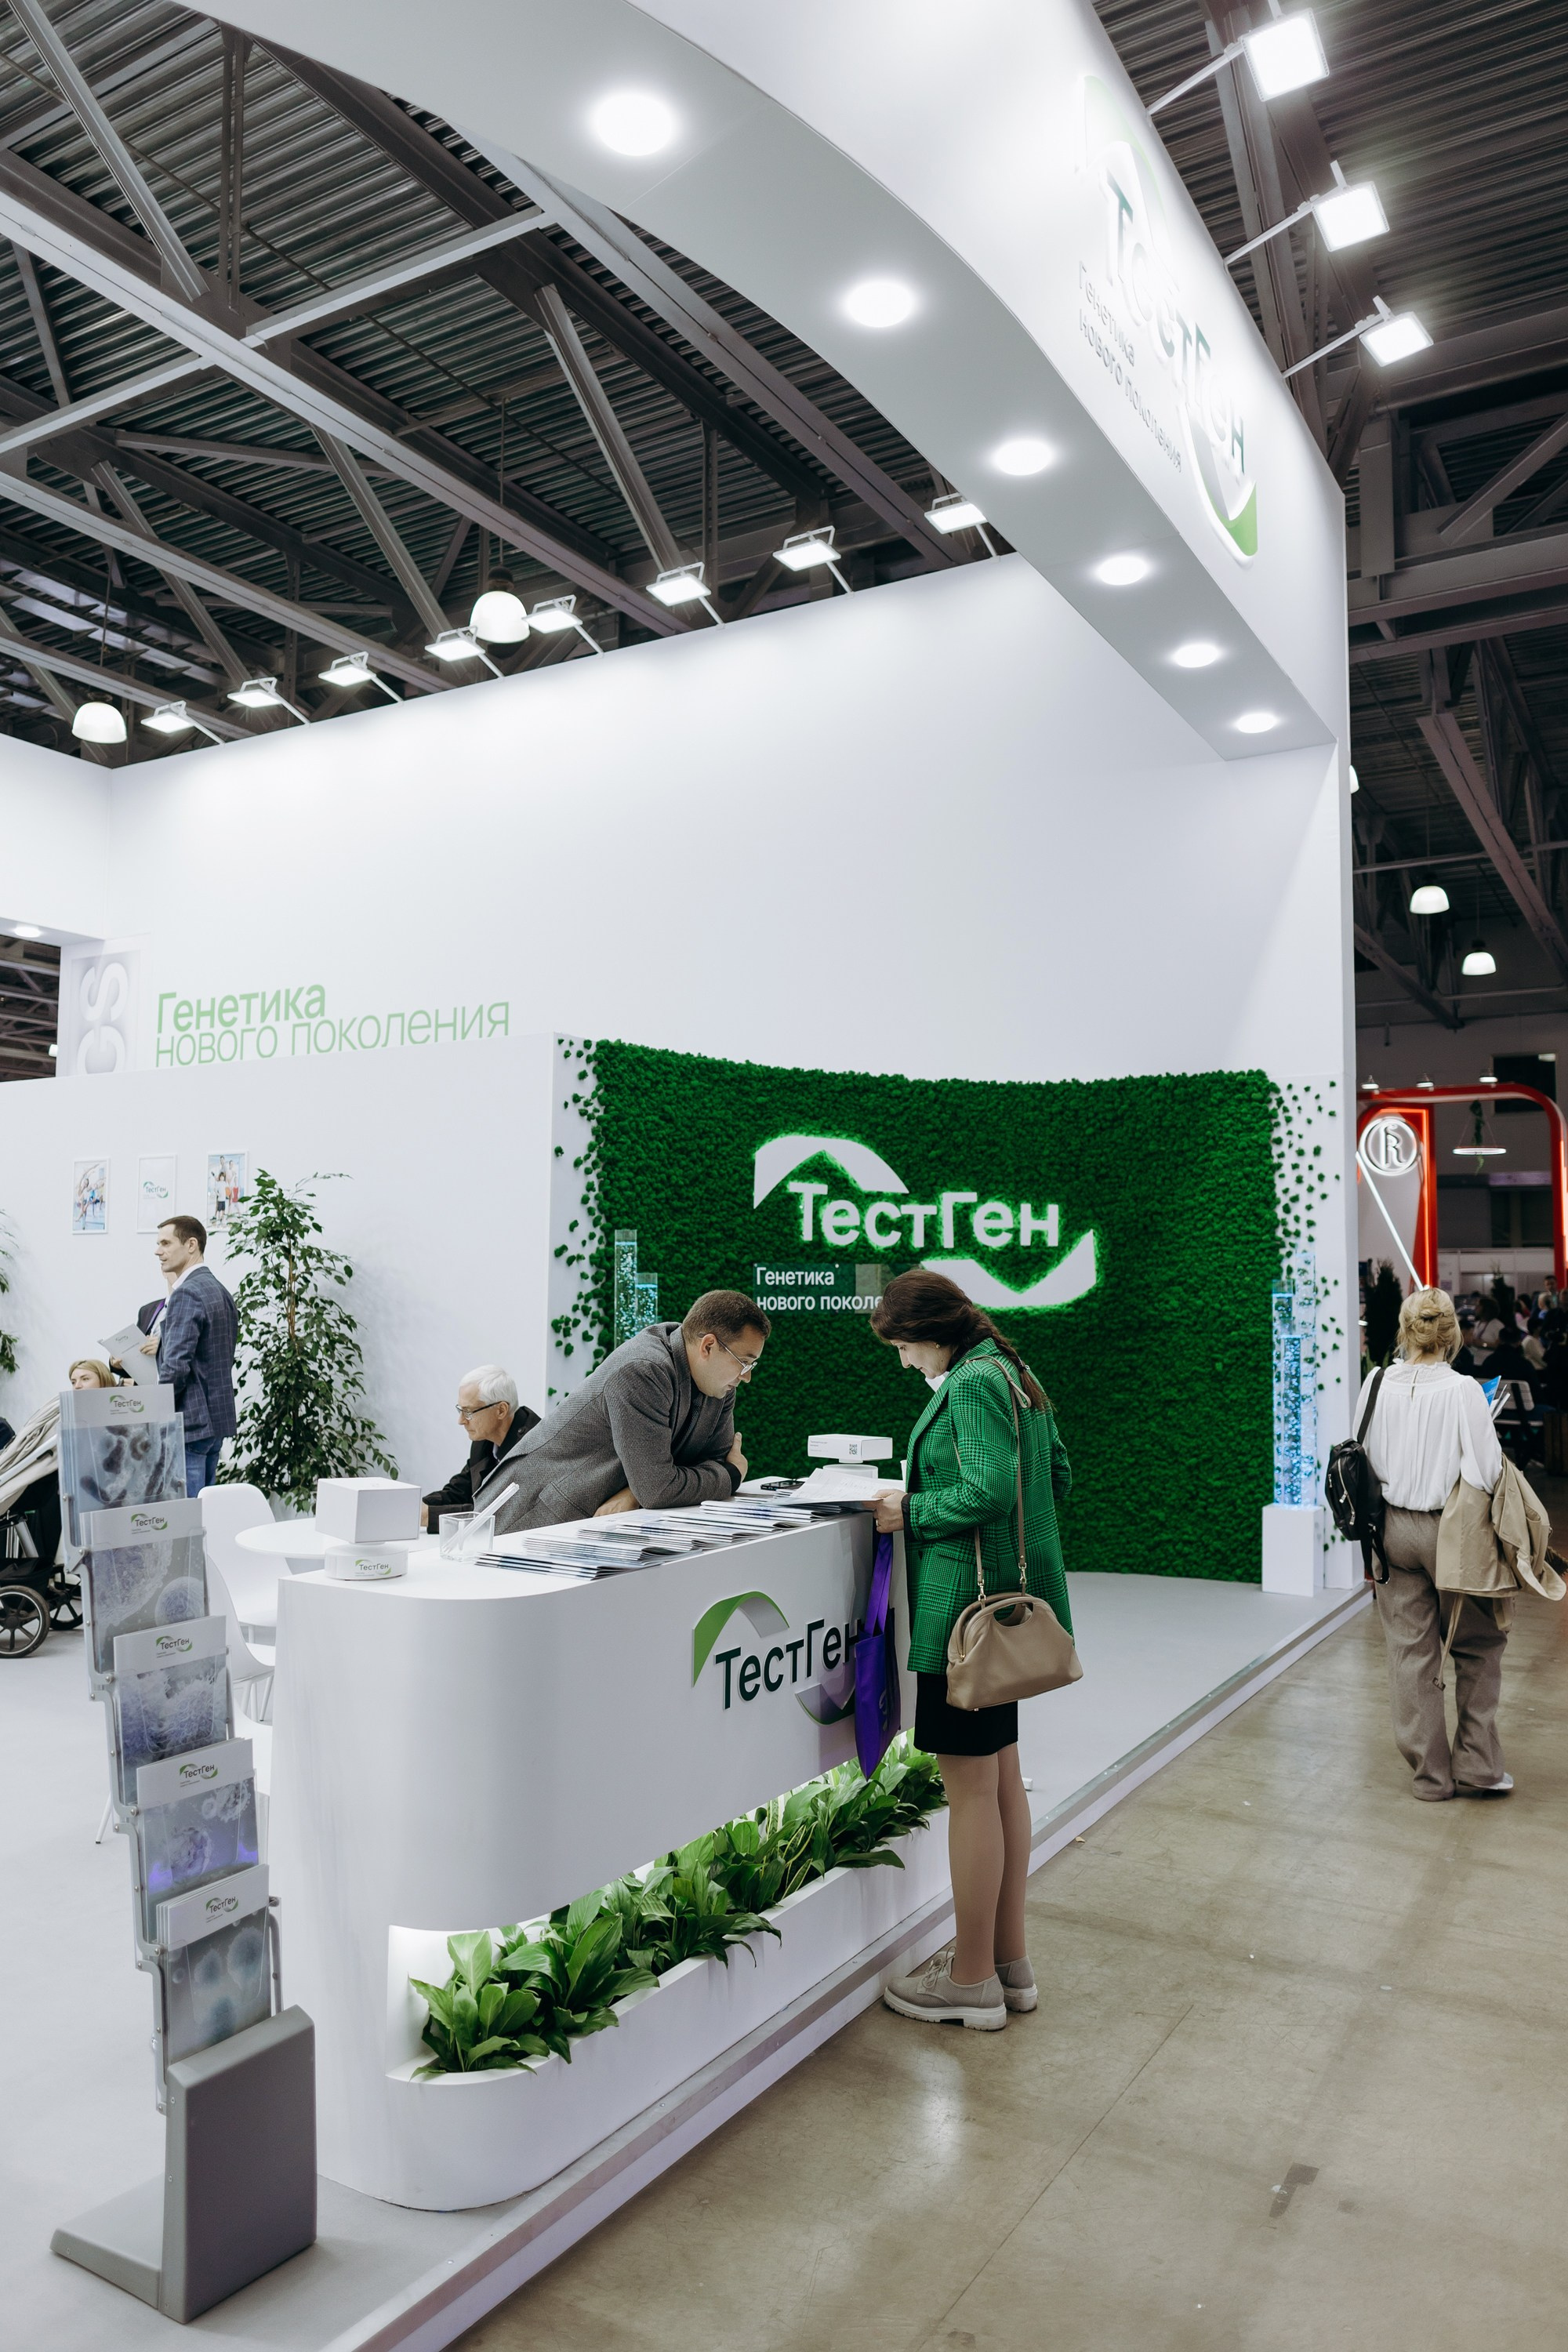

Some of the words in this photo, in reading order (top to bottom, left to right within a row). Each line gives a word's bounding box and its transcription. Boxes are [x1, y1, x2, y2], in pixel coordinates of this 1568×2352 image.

[1079, 260, 1135, 368] Генетика
[1079, 307, 1123, 387] нового
[158, 984, 325, 1033] Генетика
[156, 1025, 278, 1068] нового
[291, 1001, 510, 1056] поколения
[789, 1181, 1059, 1249] ТестГен
[756, 1267, 835, 1286] Генетика
[757, 1296, 816, 1311] нового
[114, 1399, 142, 1408] ТестГен
[134, 1517, 165, 1527] ТестГен
[359, 1563, 389, 1571] ТестГен
[160, 1638, 190, 1650] ТестГен
[714, 1618, 863, 1711] ТестГен
[183, 1764, 215, 1778] ТестГен
[209, 1896, 236, 1913] ТестГен
